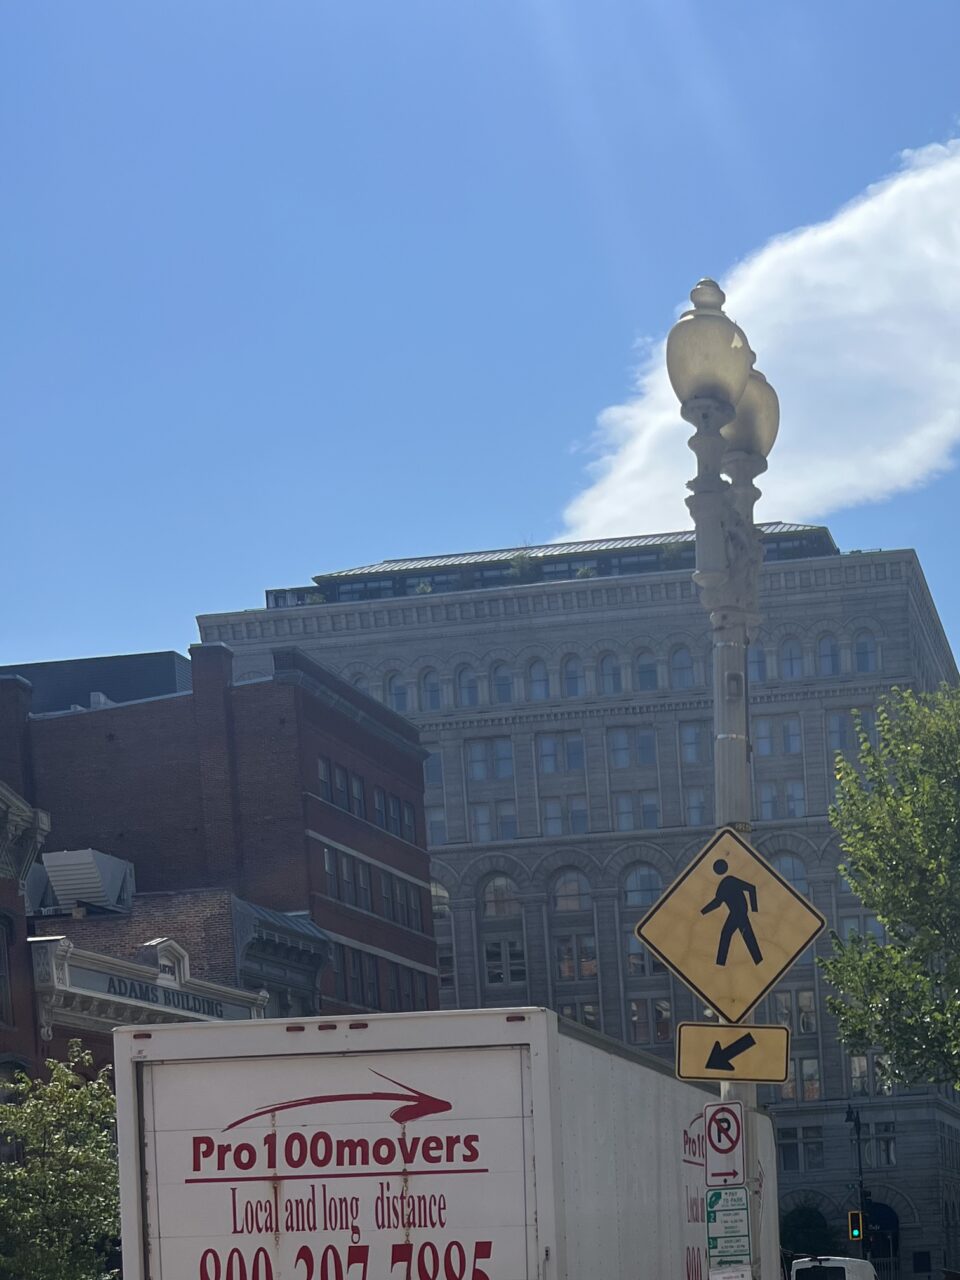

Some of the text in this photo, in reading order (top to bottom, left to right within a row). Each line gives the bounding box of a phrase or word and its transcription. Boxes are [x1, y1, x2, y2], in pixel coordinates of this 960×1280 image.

[106, 976, 224, 1019] ADAMS BUILDING
[192, 1131, 480, 1172] Pro100movers
[230, 1181, 447, 1244] Local and long distance
